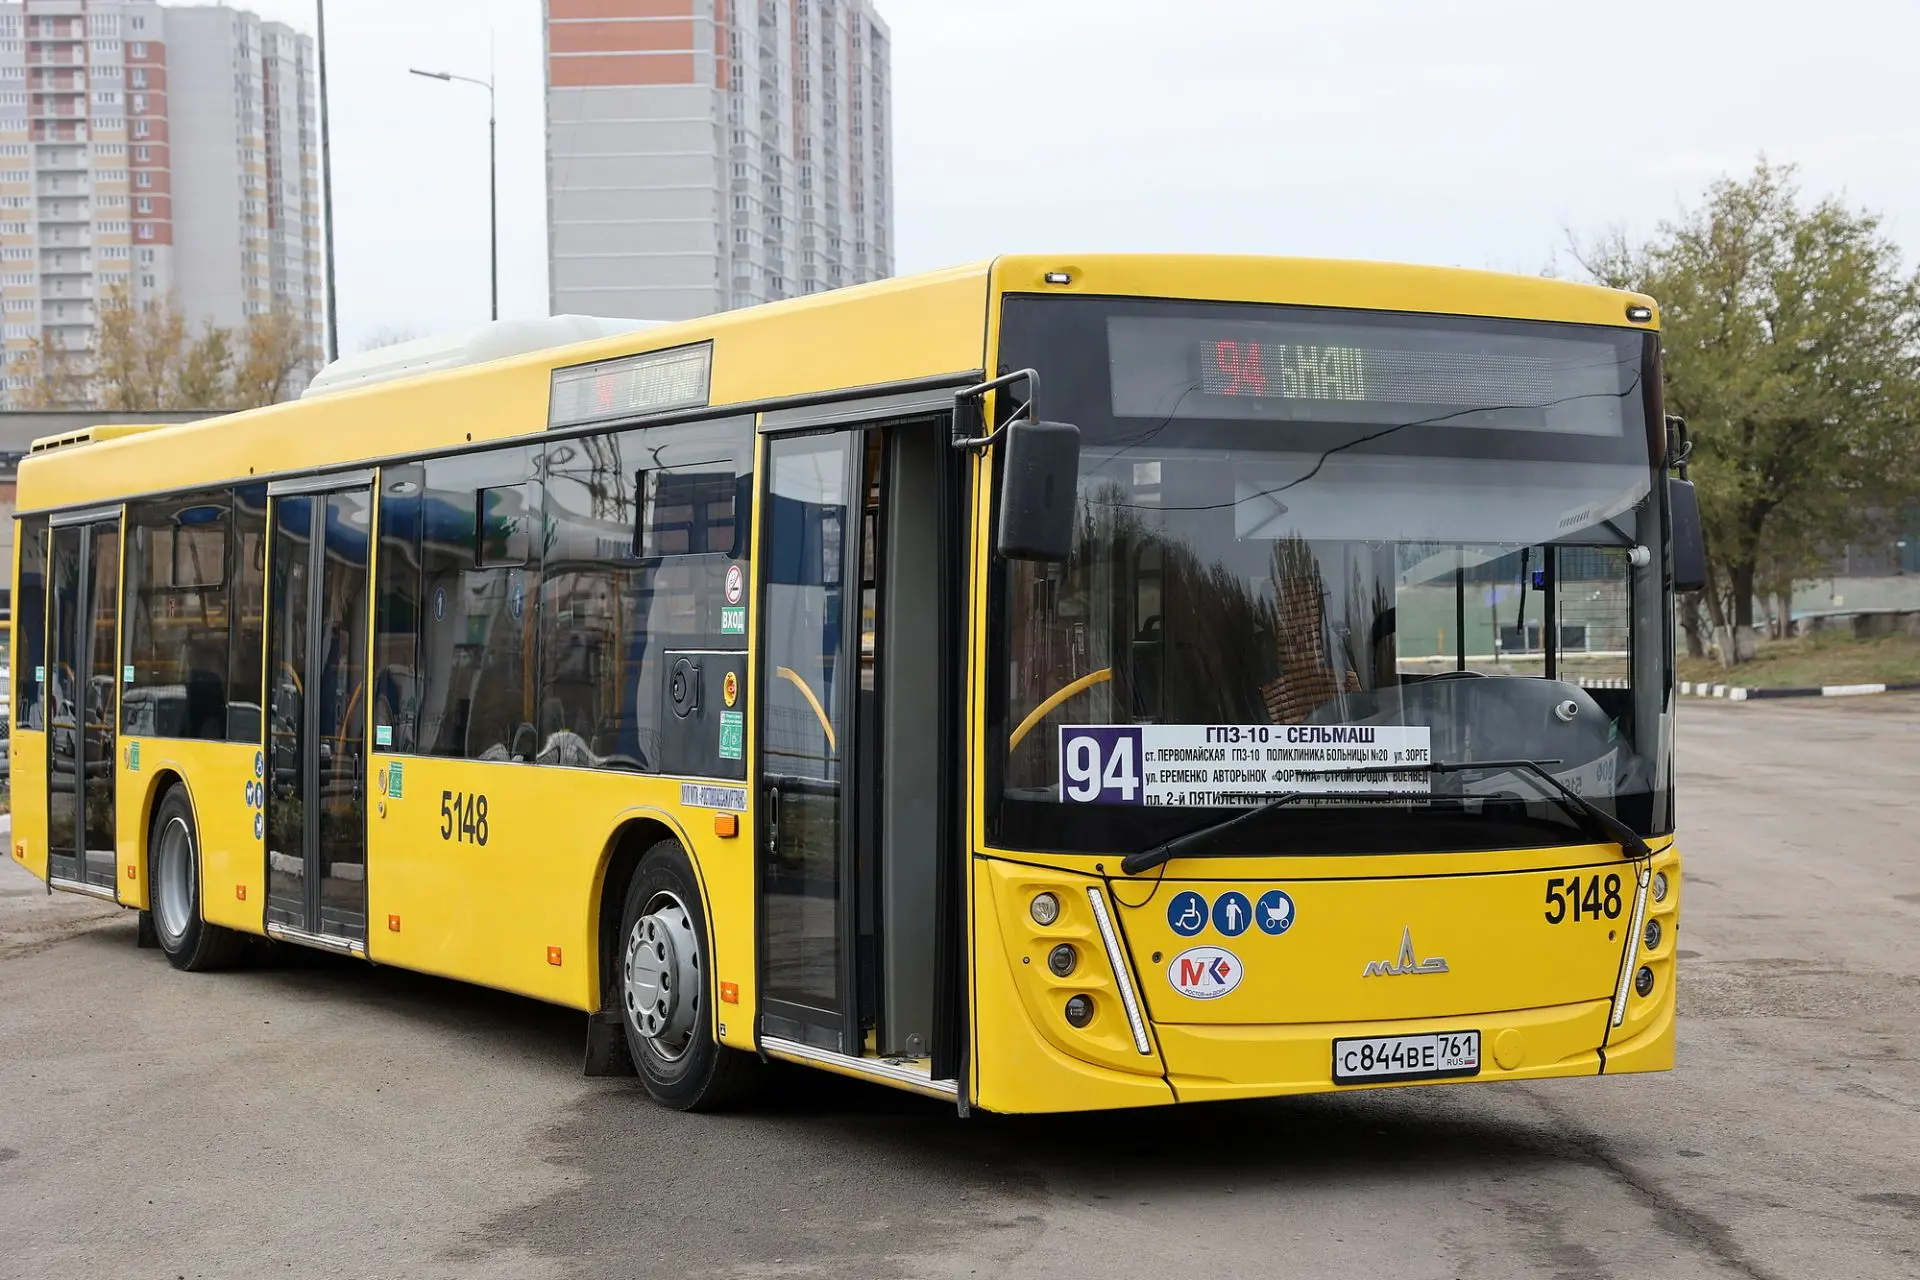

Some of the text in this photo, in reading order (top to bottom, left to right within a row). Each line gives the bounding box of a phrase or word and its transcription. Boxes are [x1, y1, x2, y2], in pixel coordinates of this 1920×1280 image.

[1218, 341, 1266, 397] 94
[723, 611, 744, 632] ВХОД
[1206, 727, 1269, 743] ГПЗ-10
[1287, 727, 1375, 743] СЕЛЬМАШ
[1145, 751, 1156, 761] ст.
[1158, 746, 1225, 761] ПЕРВОМАЙСКАЯ
[1232, 749, 1260, 761] ГПЗ-10
[1267, 749, 1325, 761] ПОЛИКЛИНИКА
[1327, 749, 1370, 763] БОЛЬНИЦЫ
[1406, 749, 1428, 761] ЗОРГЕ
[1066, 736, 1139, 802] 94
[1145, 773, 1158, 785] ул.
[1160, 769, 1208, 783] ЕРЕМЕНКО
[1213, 769, 1267, 783] АВТОРЫНОК
[1146, 795, 1163, 806] пл.
[1166, 791, 1185, 806] 2-й
[441, 790, 488, 847] 5148
[1545, 874, 1622, 924] 5148
[1344, 1036, 1472, 1072] С844ВЕ 761
[1447, 1057, 1464, 1066] RUS
